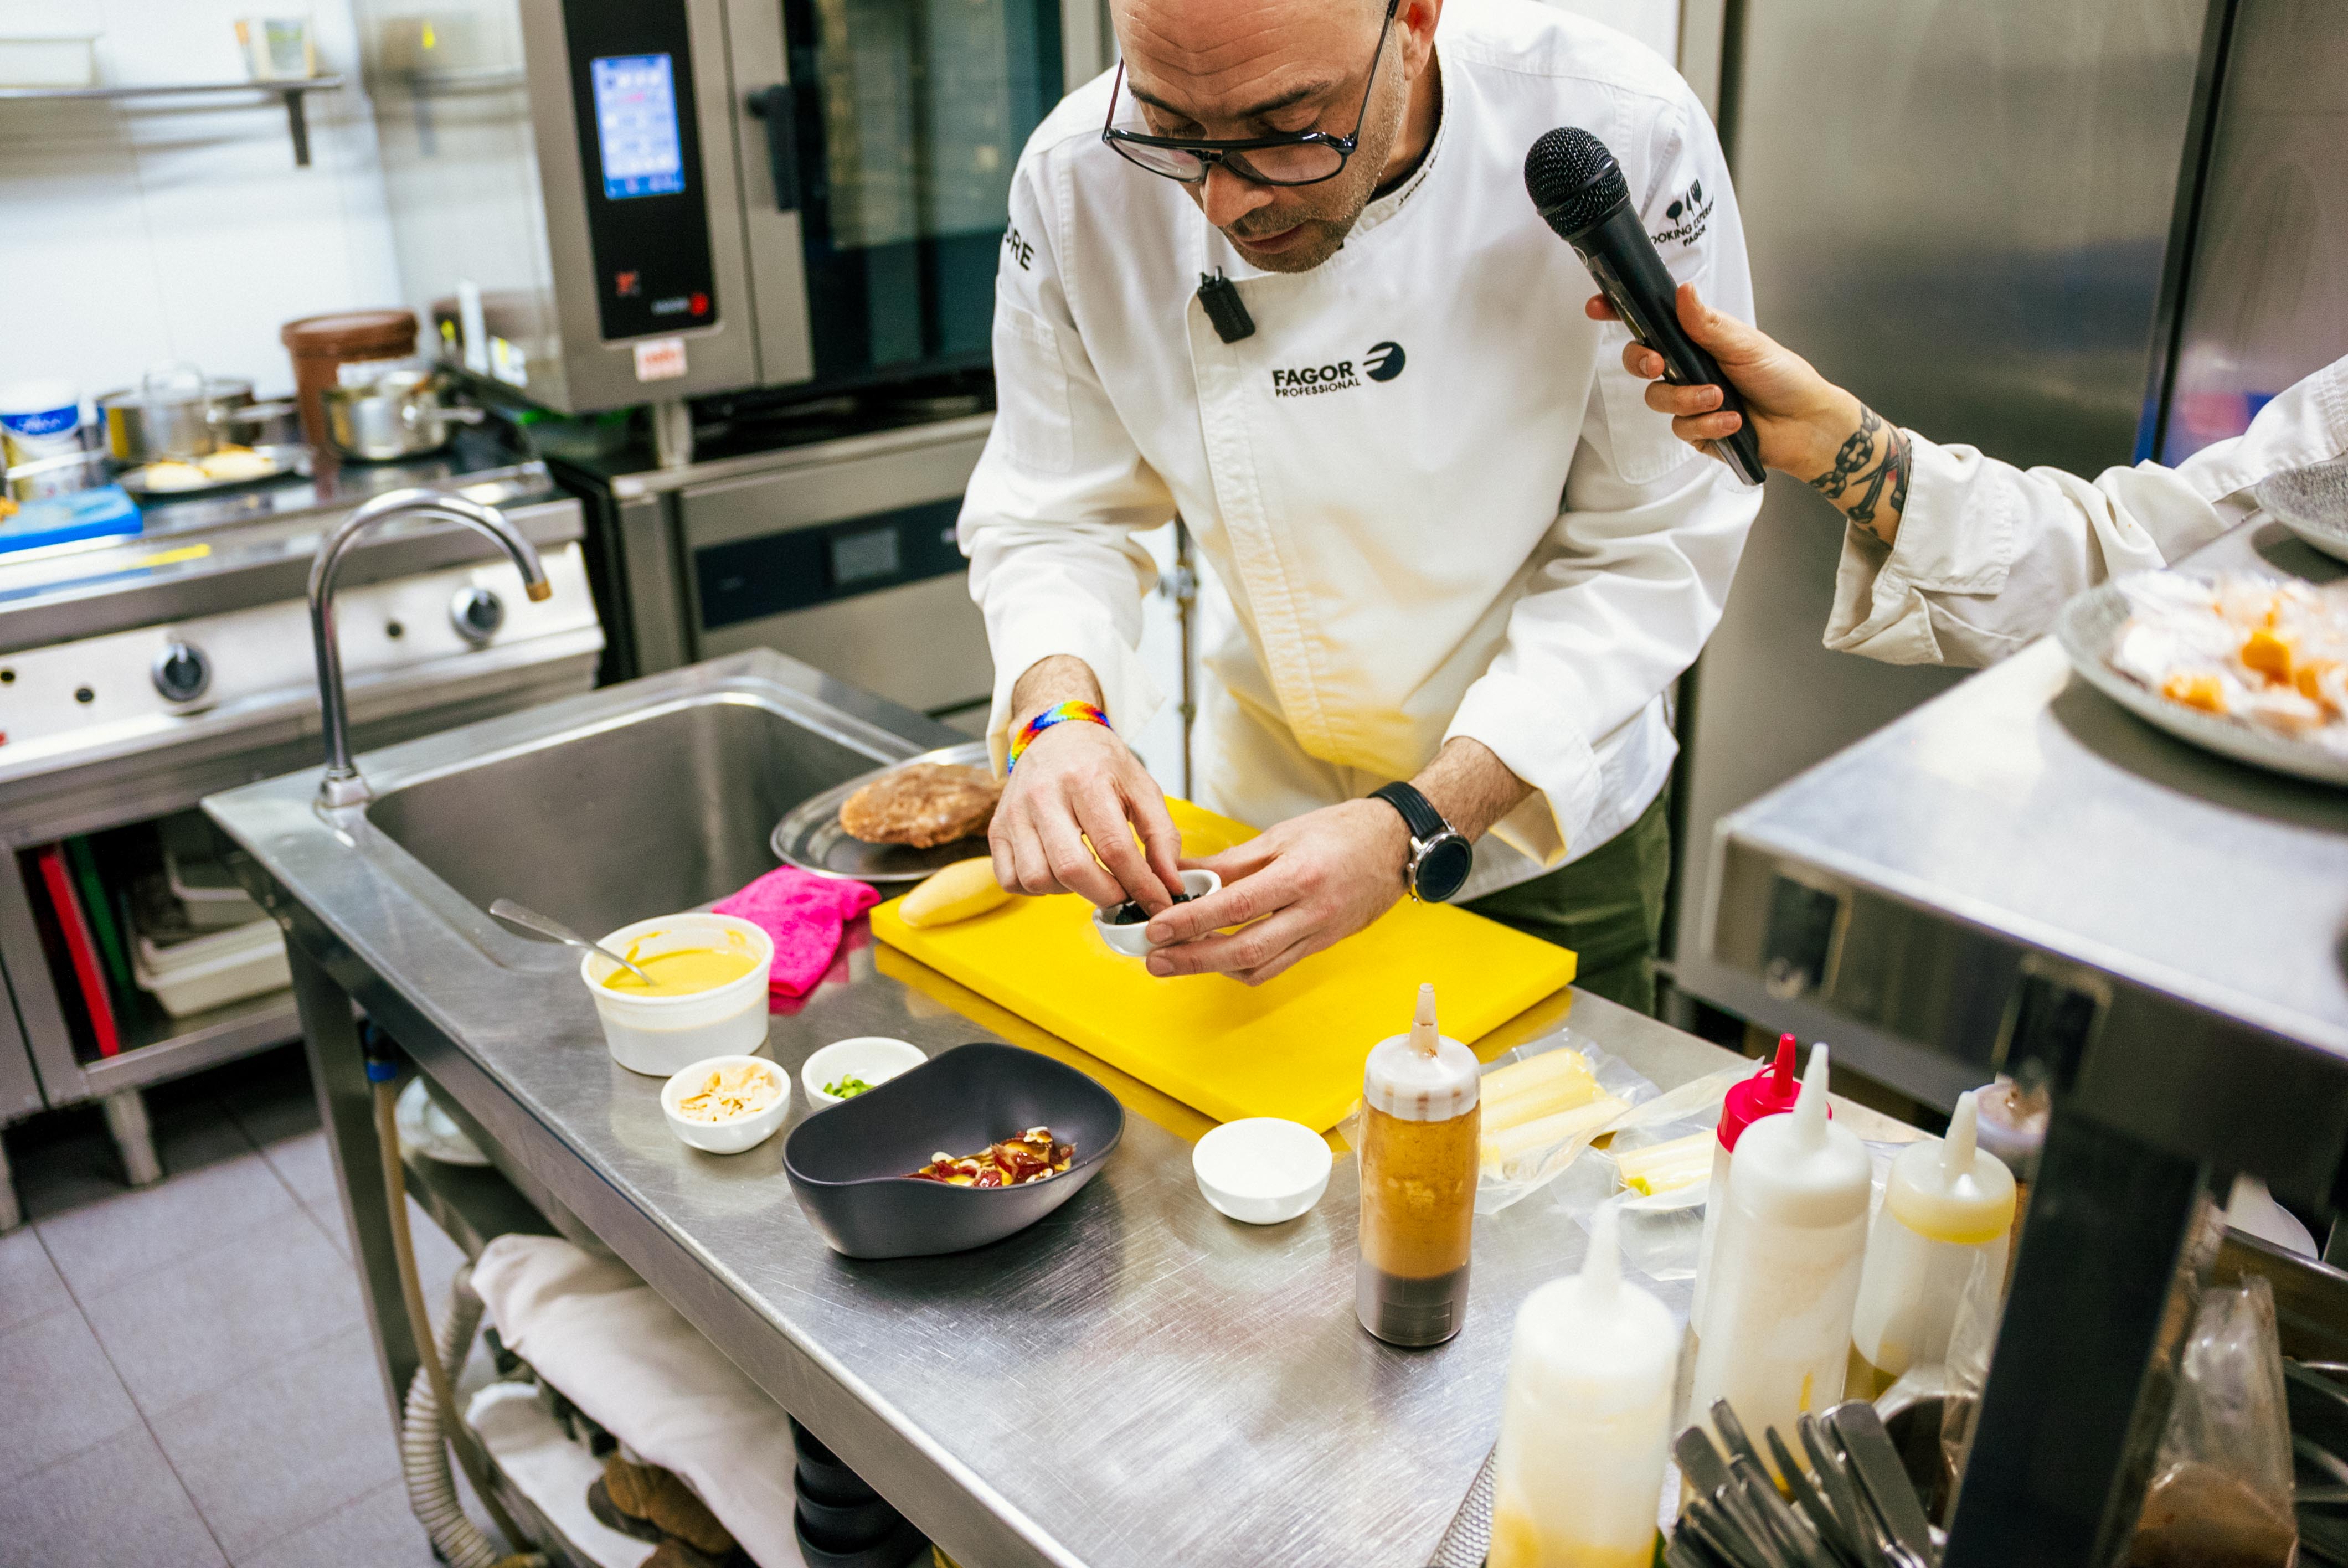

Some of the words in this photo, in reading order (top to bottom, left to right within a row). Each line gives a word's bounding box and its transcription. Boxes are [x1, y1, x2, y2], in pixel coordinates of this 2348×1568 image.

[1650, 224, 1692, 244] OOKING
[1682, 224, 1706, 247] FAGOR
[1273, 361, 1355, 386] FAGOR
[1275, 378, 1361, 398] PROFESSIONAL
